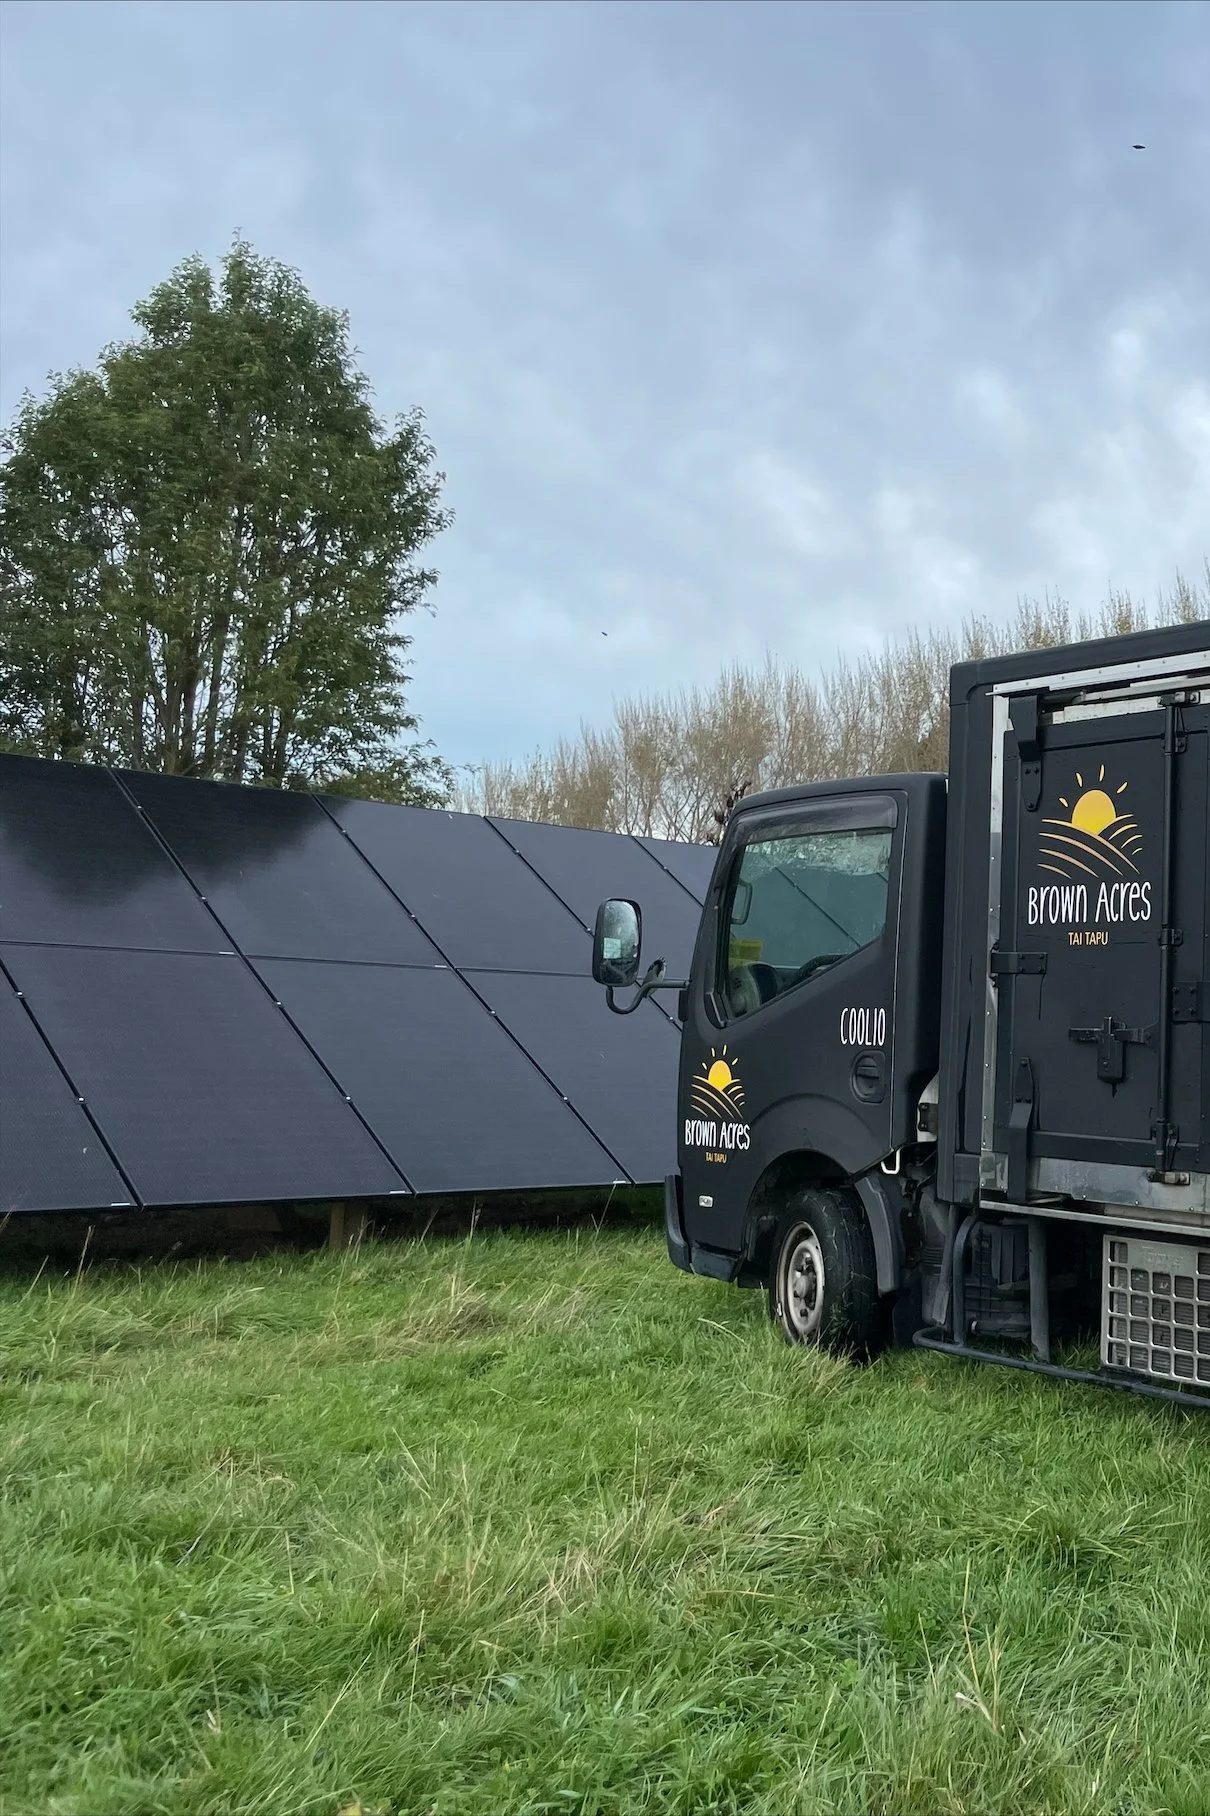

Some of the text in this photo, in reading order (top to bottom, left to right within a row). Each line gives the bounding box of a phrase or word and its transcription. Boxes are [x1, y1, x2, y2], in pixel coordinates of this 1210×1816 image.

[1028, 881, 1152, 925] Brown Acres
[1068, 931, 1109, 946] TAI TAPU
[840, 1007, 886, 1047] COOLIO
[685, 1119, 751, 1151] Brown Acres
[714, 1152, 728, 1164] TAPU
